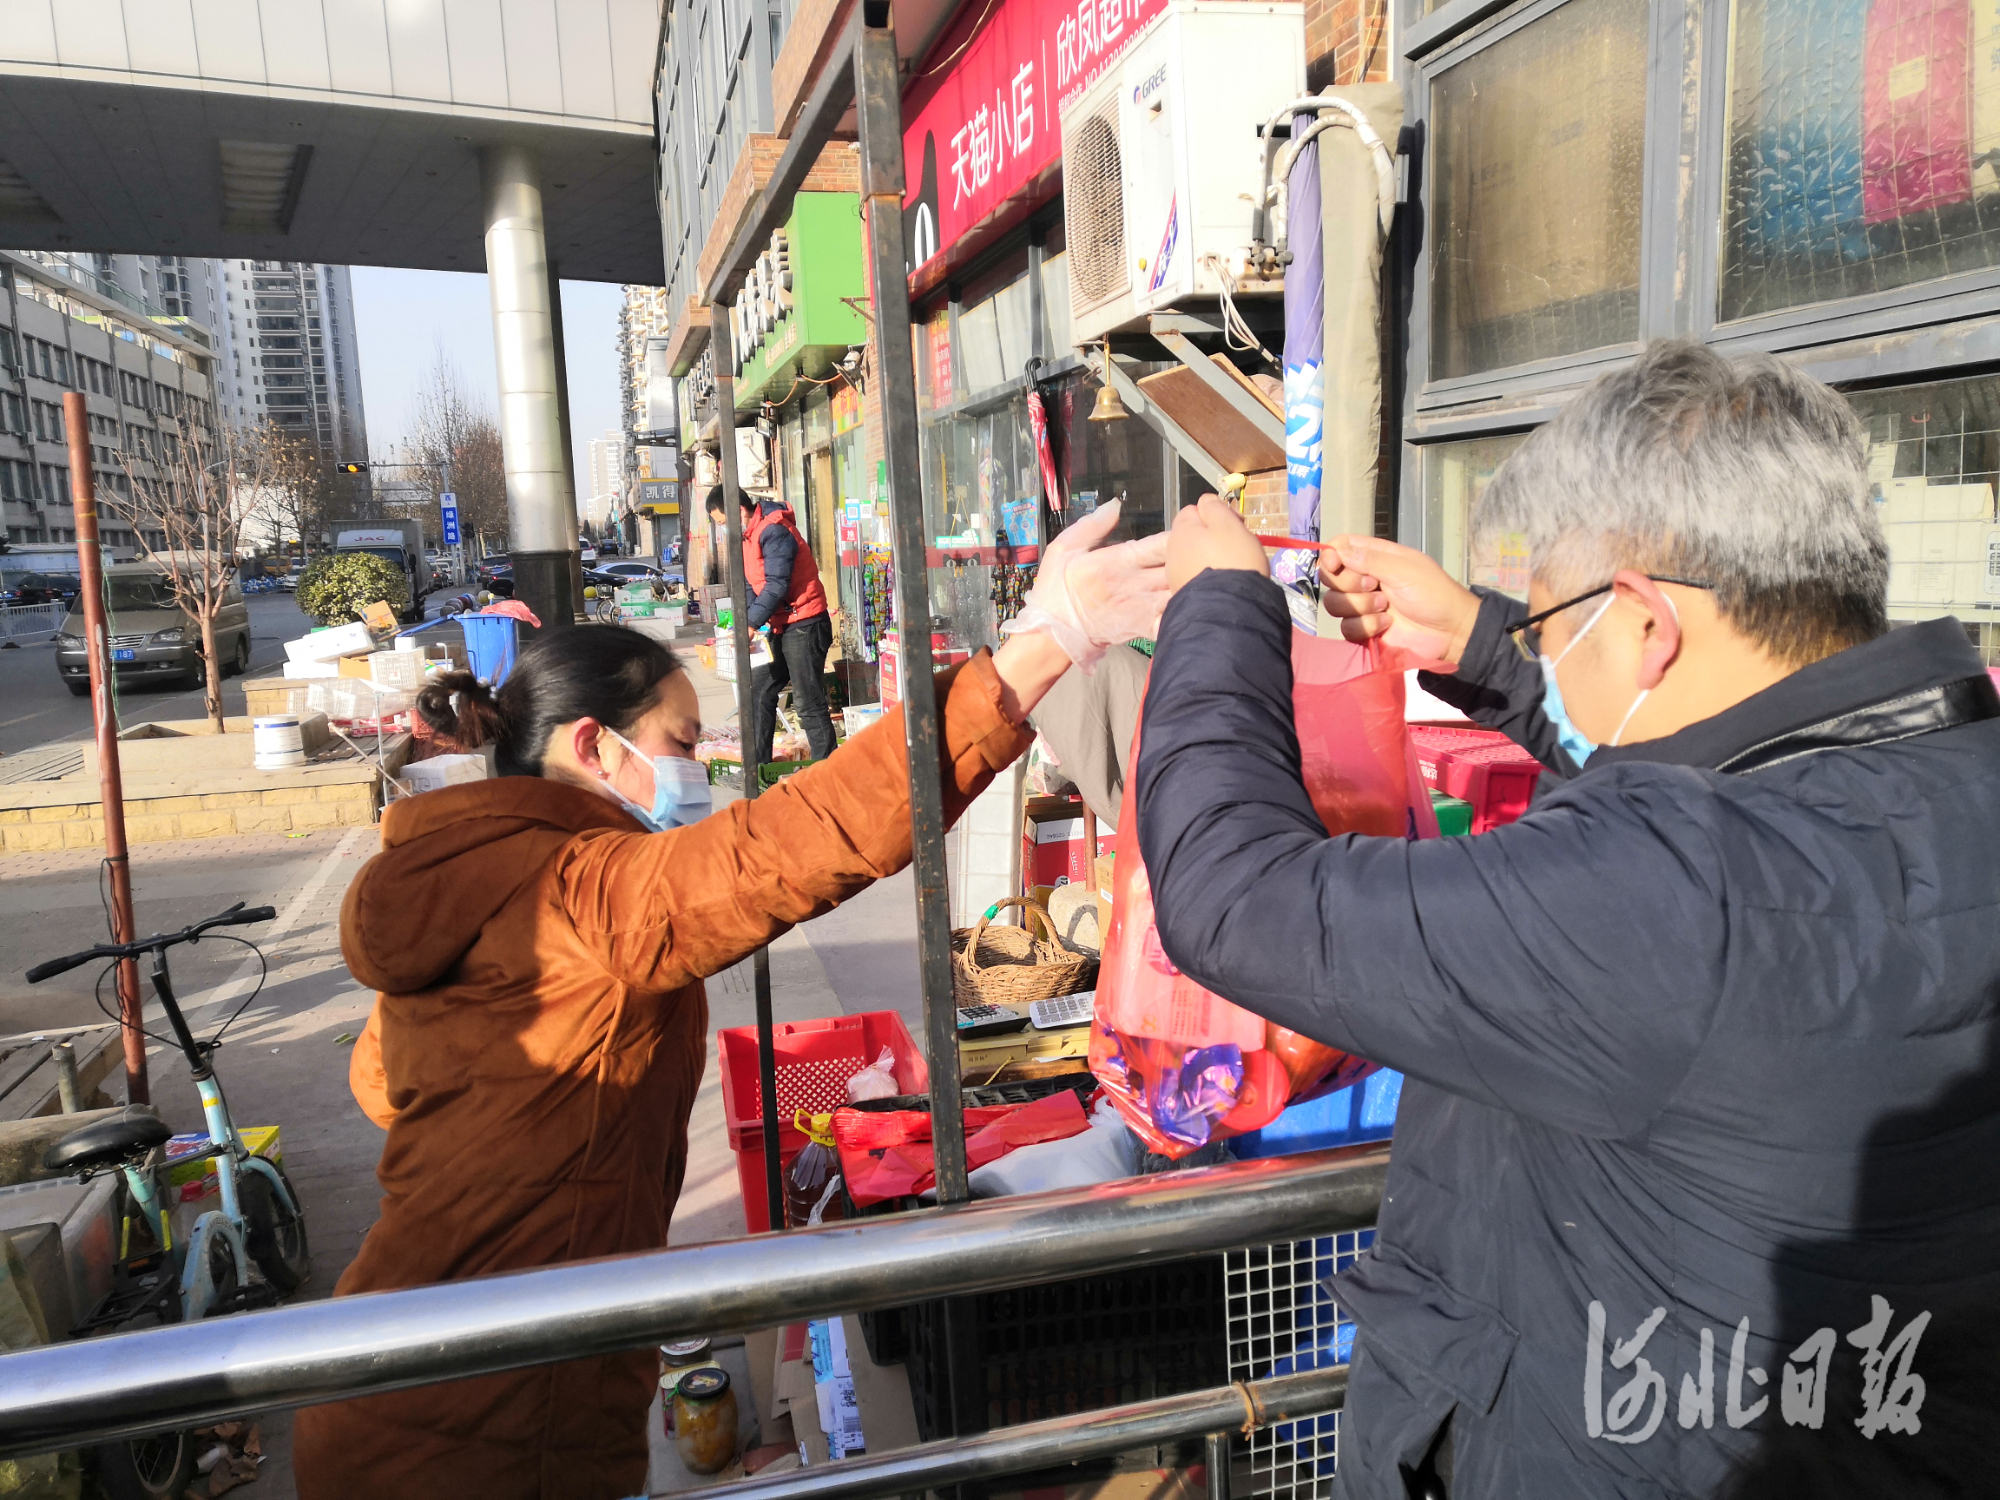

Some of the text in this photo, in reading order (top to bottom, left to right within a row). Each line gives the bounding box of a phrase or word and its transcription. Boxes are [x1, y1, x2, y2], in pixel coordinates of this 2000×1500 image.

[1142, 62, 1167, 99] GREE
[950, 60, 1033, 211] 天猫小店
[645, 484, 676, 499] 凯得
